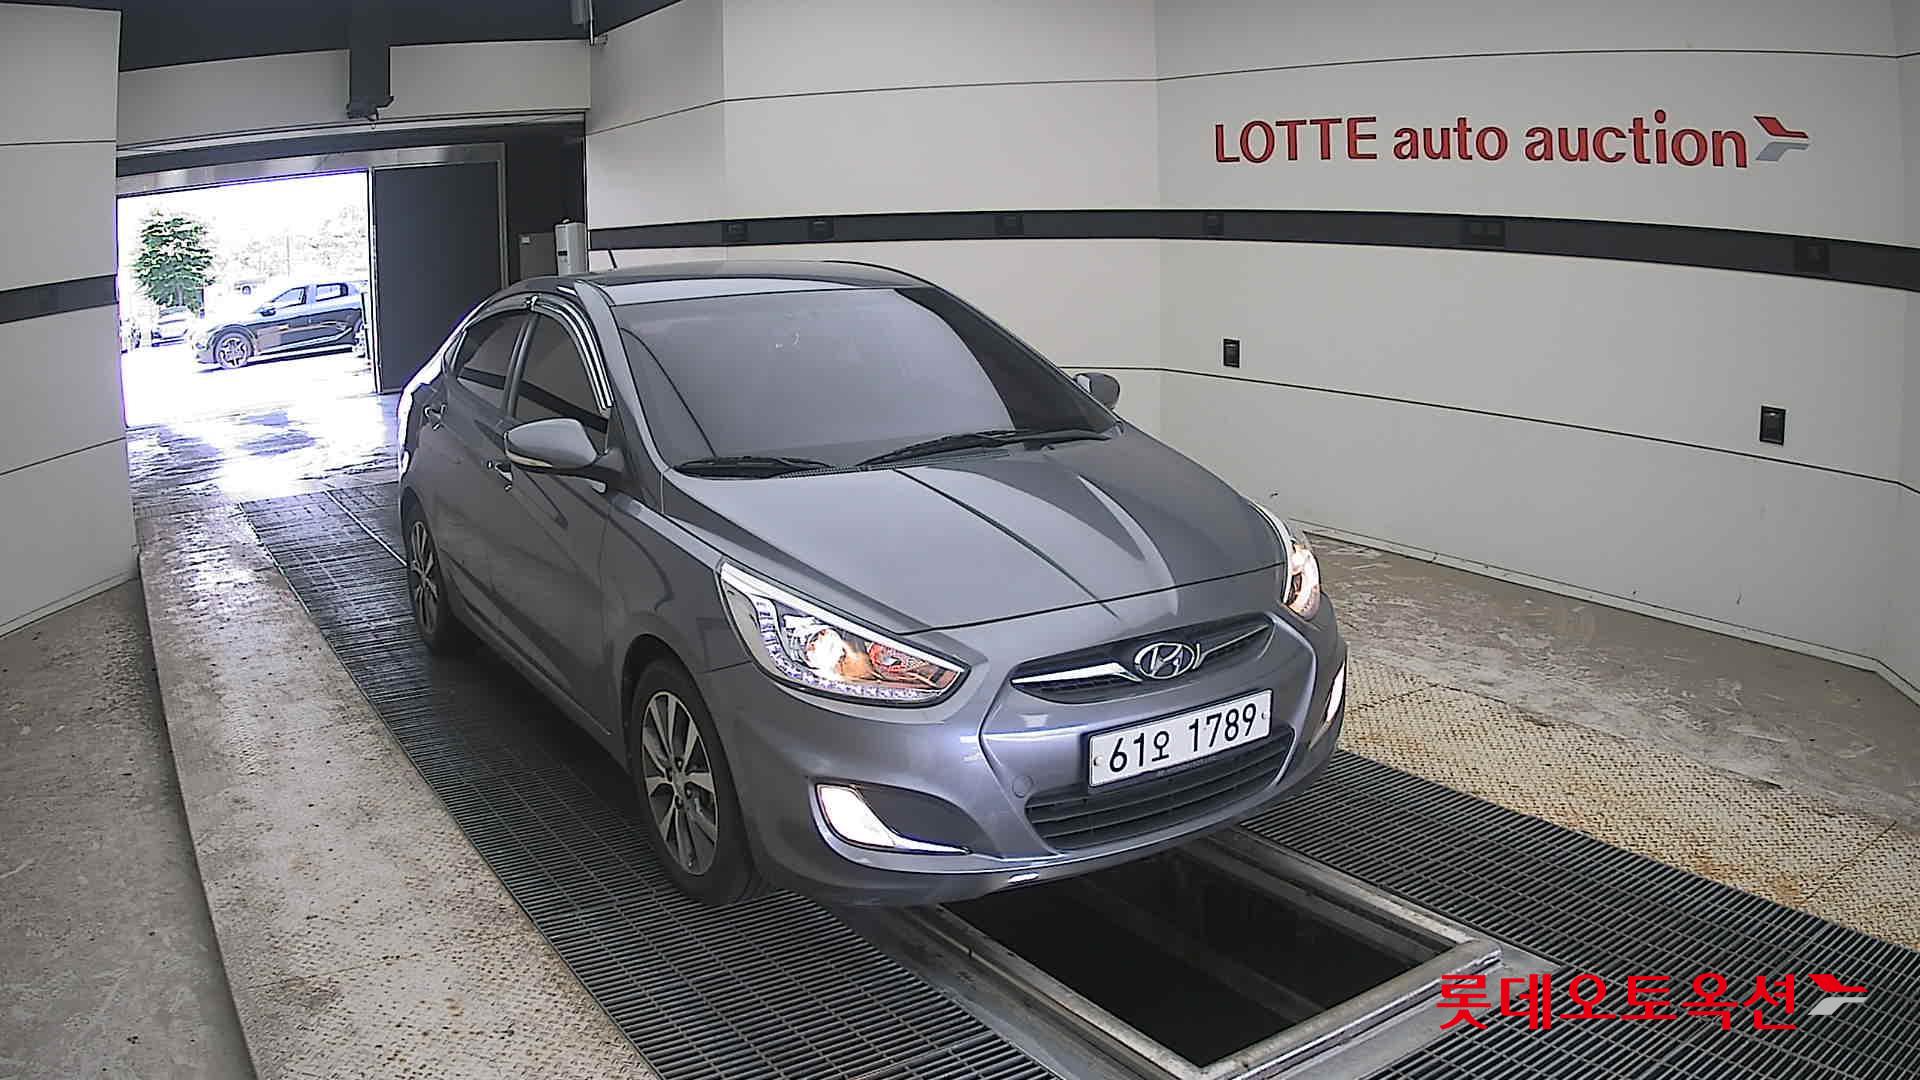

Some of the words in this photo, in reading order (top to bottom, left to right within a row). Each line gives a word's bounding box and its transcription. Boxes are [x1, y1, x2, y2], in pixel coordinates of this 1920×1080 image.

[1215, 116, 1378, 163] LOTTE
[1393, 117, 1508, 161] auto
[1524, 109, 1748, 168] auction
[1109, 730, 1170, 773] 61오
[1188, 703, 1257, 752] 1789
